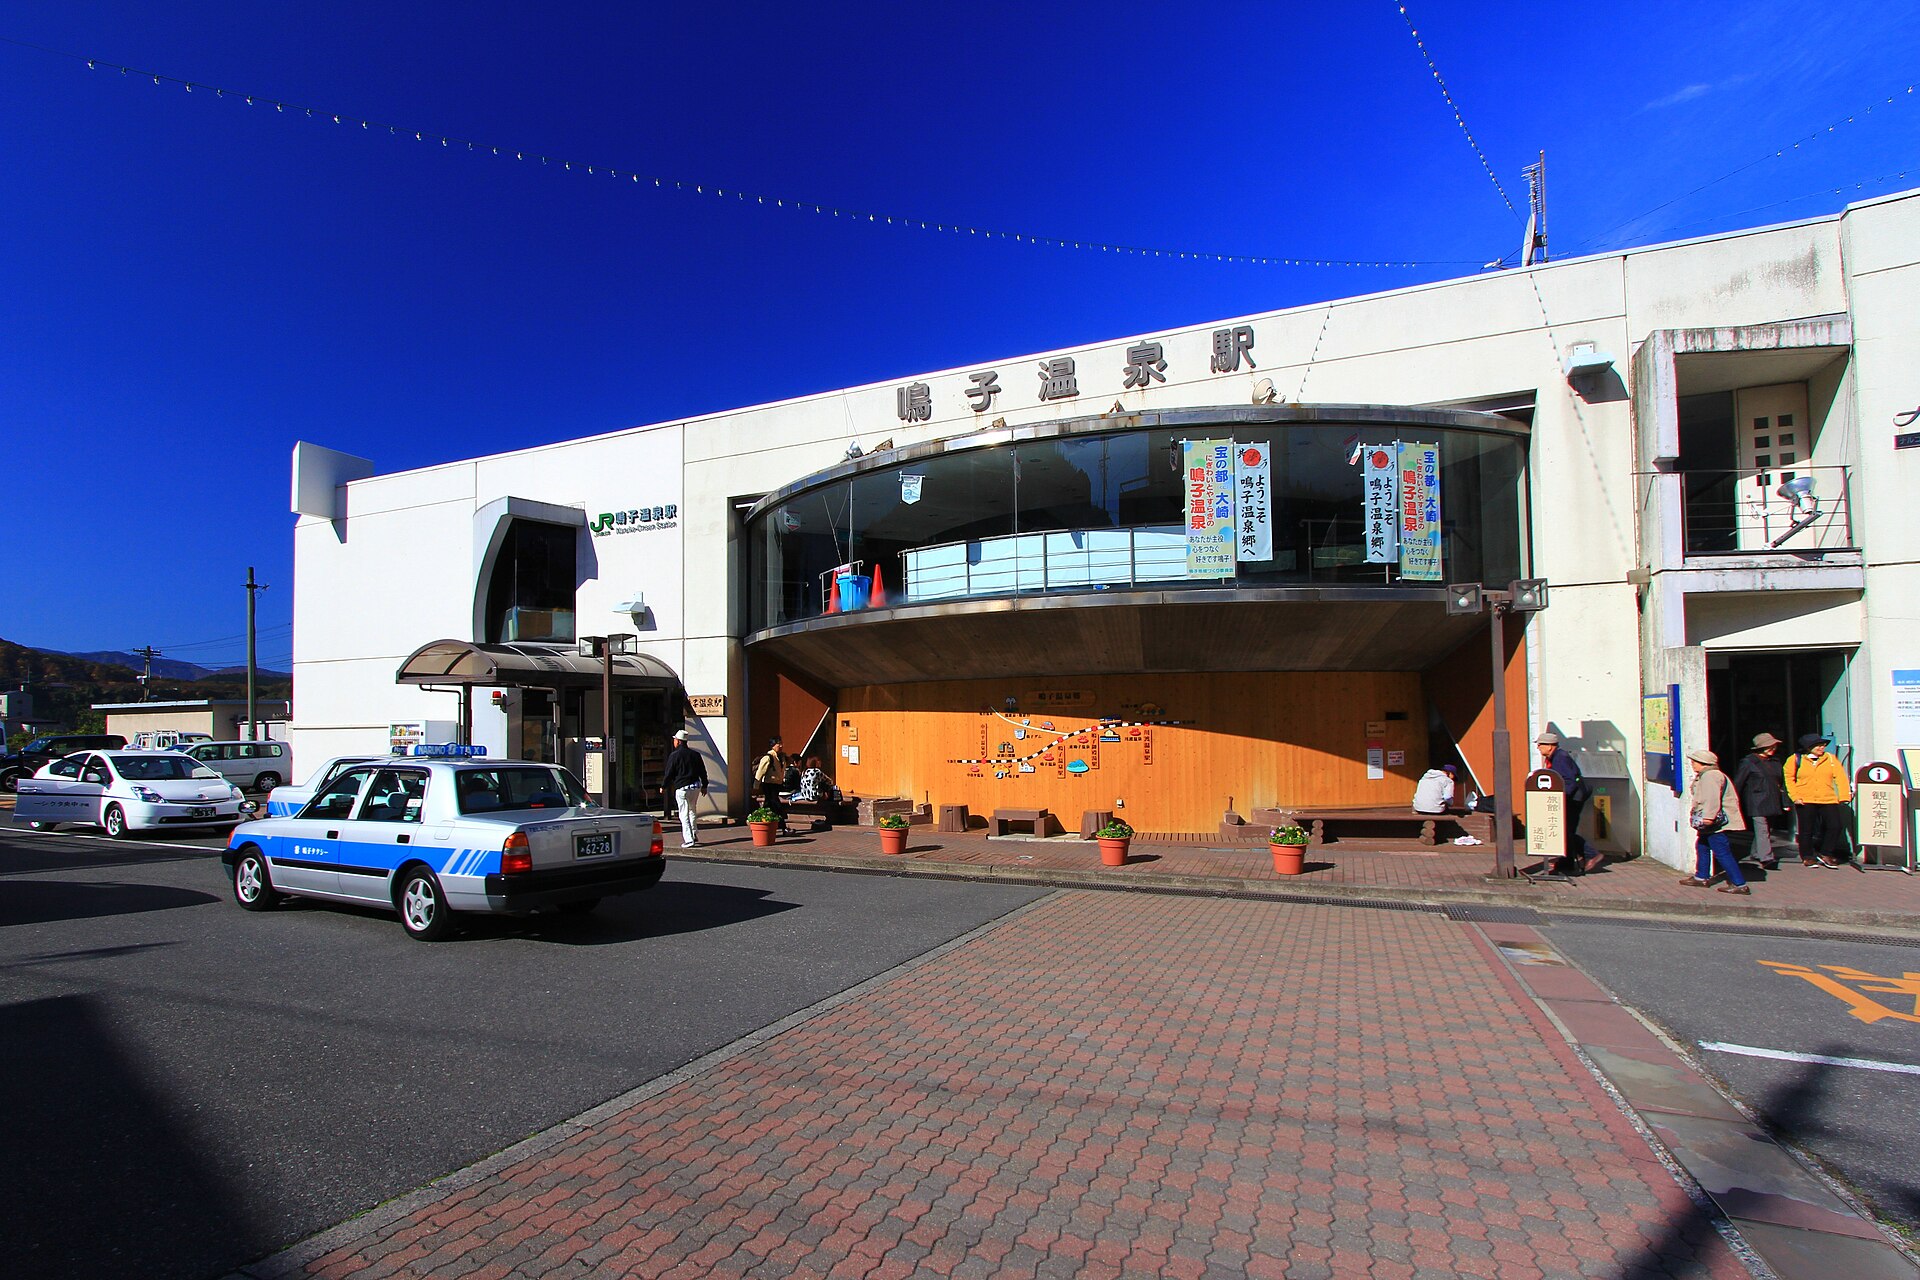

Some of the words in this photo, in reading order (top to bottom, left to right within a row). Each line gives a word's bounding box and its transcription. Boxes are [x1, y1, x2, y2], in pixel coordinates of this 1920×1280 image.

[897, 325, 1256, 423] 鳴子温泉駅
[1214, 446, 1229, 482] 宝の都
[1423, 451, 1436, 487] 宝の都
[1190, 467, 1206, 529] 鳴子温泉
[1205, 455, 1215, 527] にぎわいとやすらぎの
[1216, 492, 1229, 519] 大崎
[1255, 475, 1267, 524] ようこそ
[1383, 477, 1394, 526] ようこそ
[1402, 470, 1418, 532] 鳴子温泉
[1425, 497, 1437, 523] 大崎
[590, 513, 615, 533] JR
[615, 504, 678, 525] 鳴子温泉駅
[1240, 476, 1256, 556] 鳴子温泉郷へ
[1369, 478, 1385, 558] 鳴子温泉郷へ
[688, 697, 722, 708] 子温泉駅
[418, 745, 445, 755] NARUKO
[459, 746, 485, 755] TAXI
[1547, 796, 1558, 837] 旅館・ホテル
[1872, 790, 1888, 839] 観光案内所
[585, 842, 611, 855] 62-28
[1533, 826, 1544, 850] 送迎車
